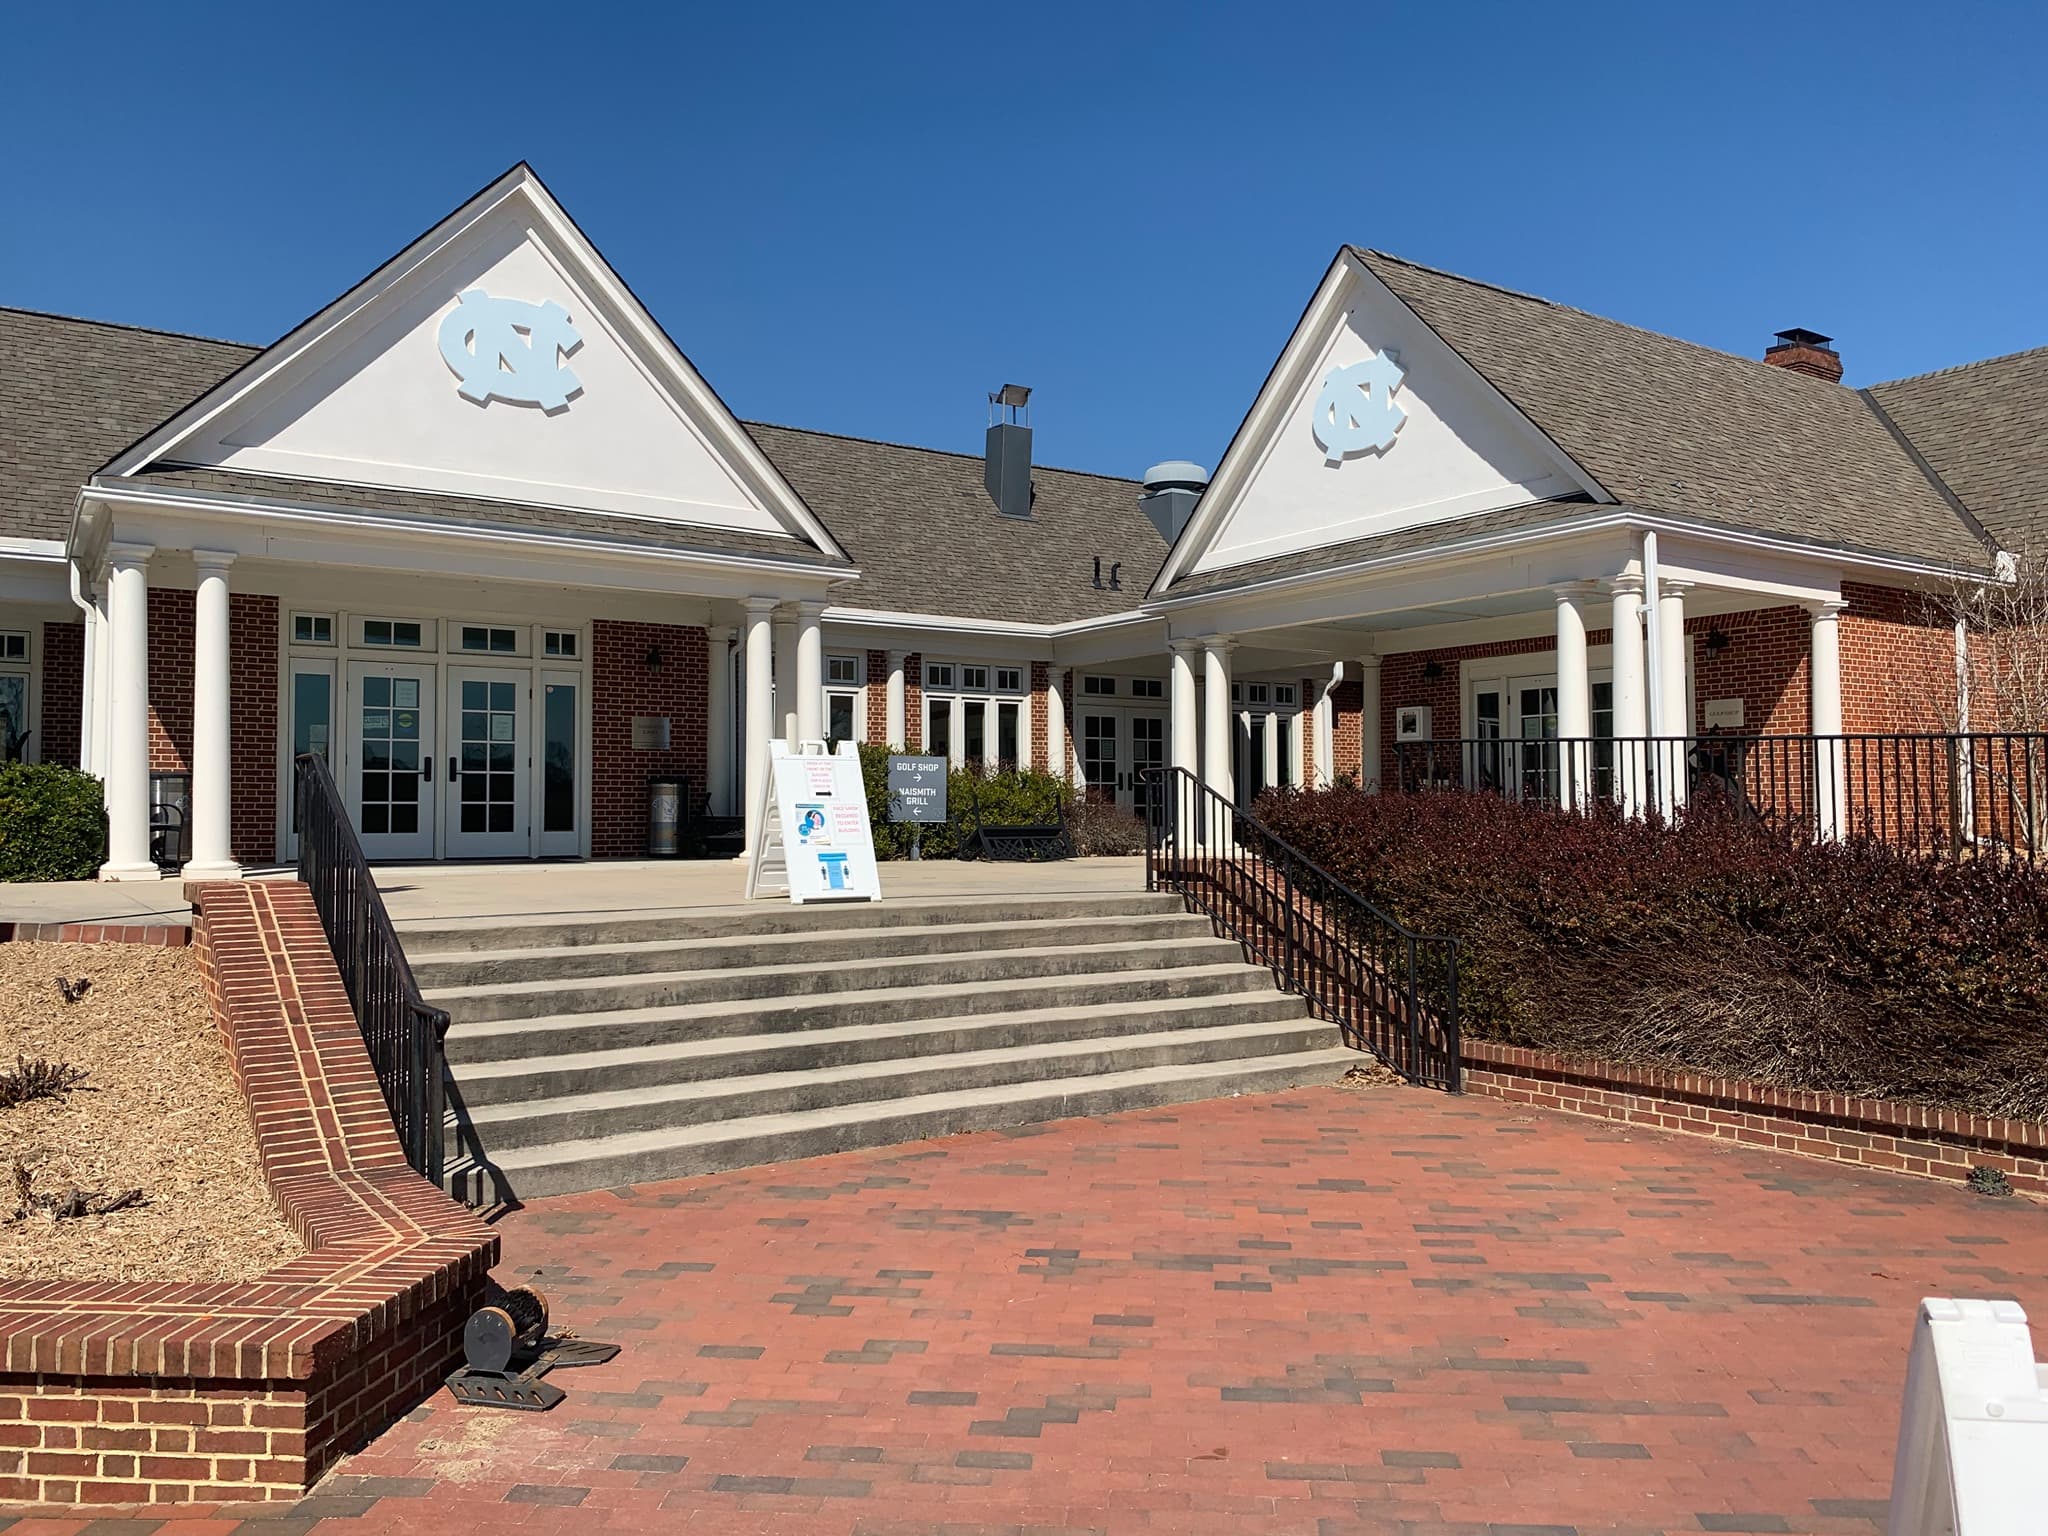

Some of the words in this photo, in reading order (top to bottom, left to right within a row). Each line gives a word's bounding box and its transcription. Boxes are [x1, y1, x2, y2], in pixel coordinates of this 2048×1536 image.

[896, 762, 917, 771] GOLF
[917, 763, 939, 772] SHOP
[898, 787, 937, 797] NAISMITH
[906, 796, 929, 806] GRILL
